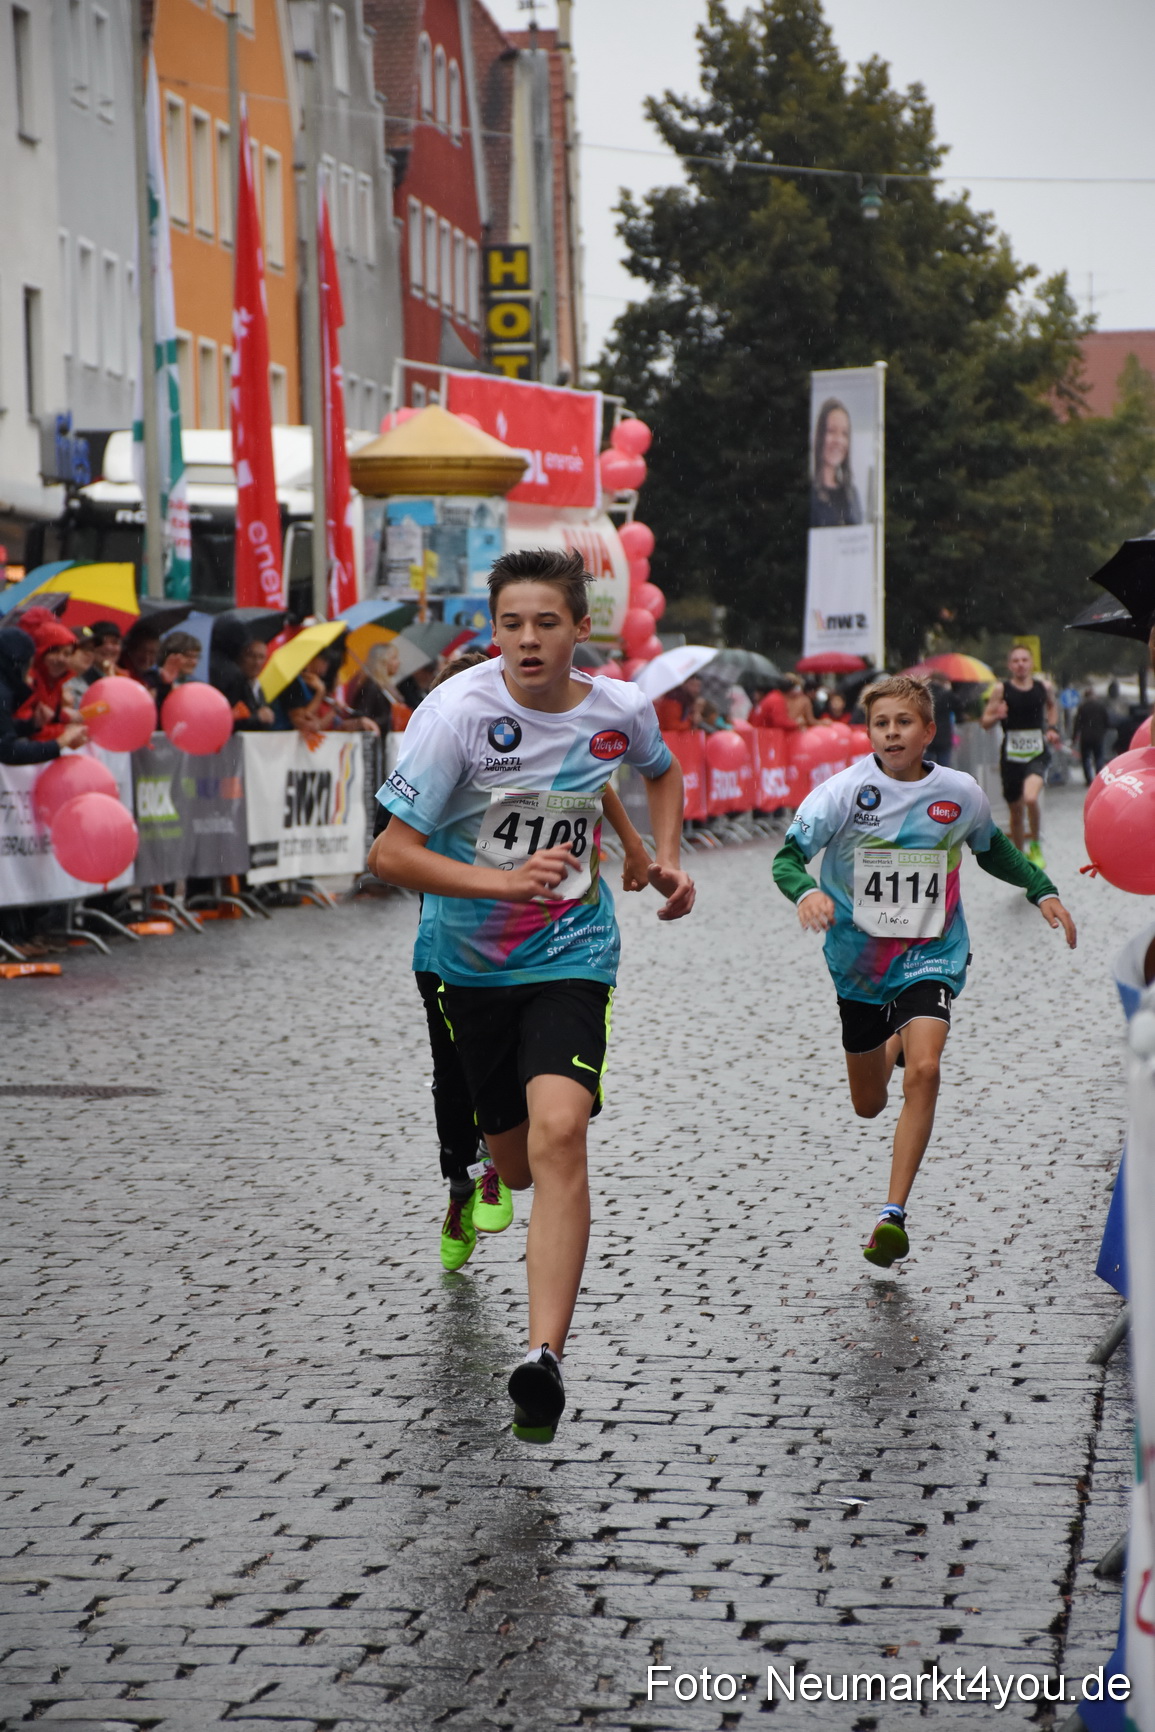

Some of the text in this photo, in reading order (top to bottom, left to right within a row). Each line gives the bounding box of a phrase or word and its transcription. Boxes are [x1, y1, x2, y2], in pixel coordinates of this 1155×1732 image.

[488, 248, 531, 379] HOT
[491, 717, 519, 730] BMW
[593, 737, 624, 753] Hervis
[485, 757, 522, 767] PARTL
[546, 795, 597, 811] BOCK
[854, 812, 880, 822] PARTL
[932, 805, 958, 819] Hervis
[493, 811, 588, 858] 4108
[898, 852, 941, 864] BOCK
[864, 871, 940, 904] 4114
[906, 949, 926, 961] 17.
